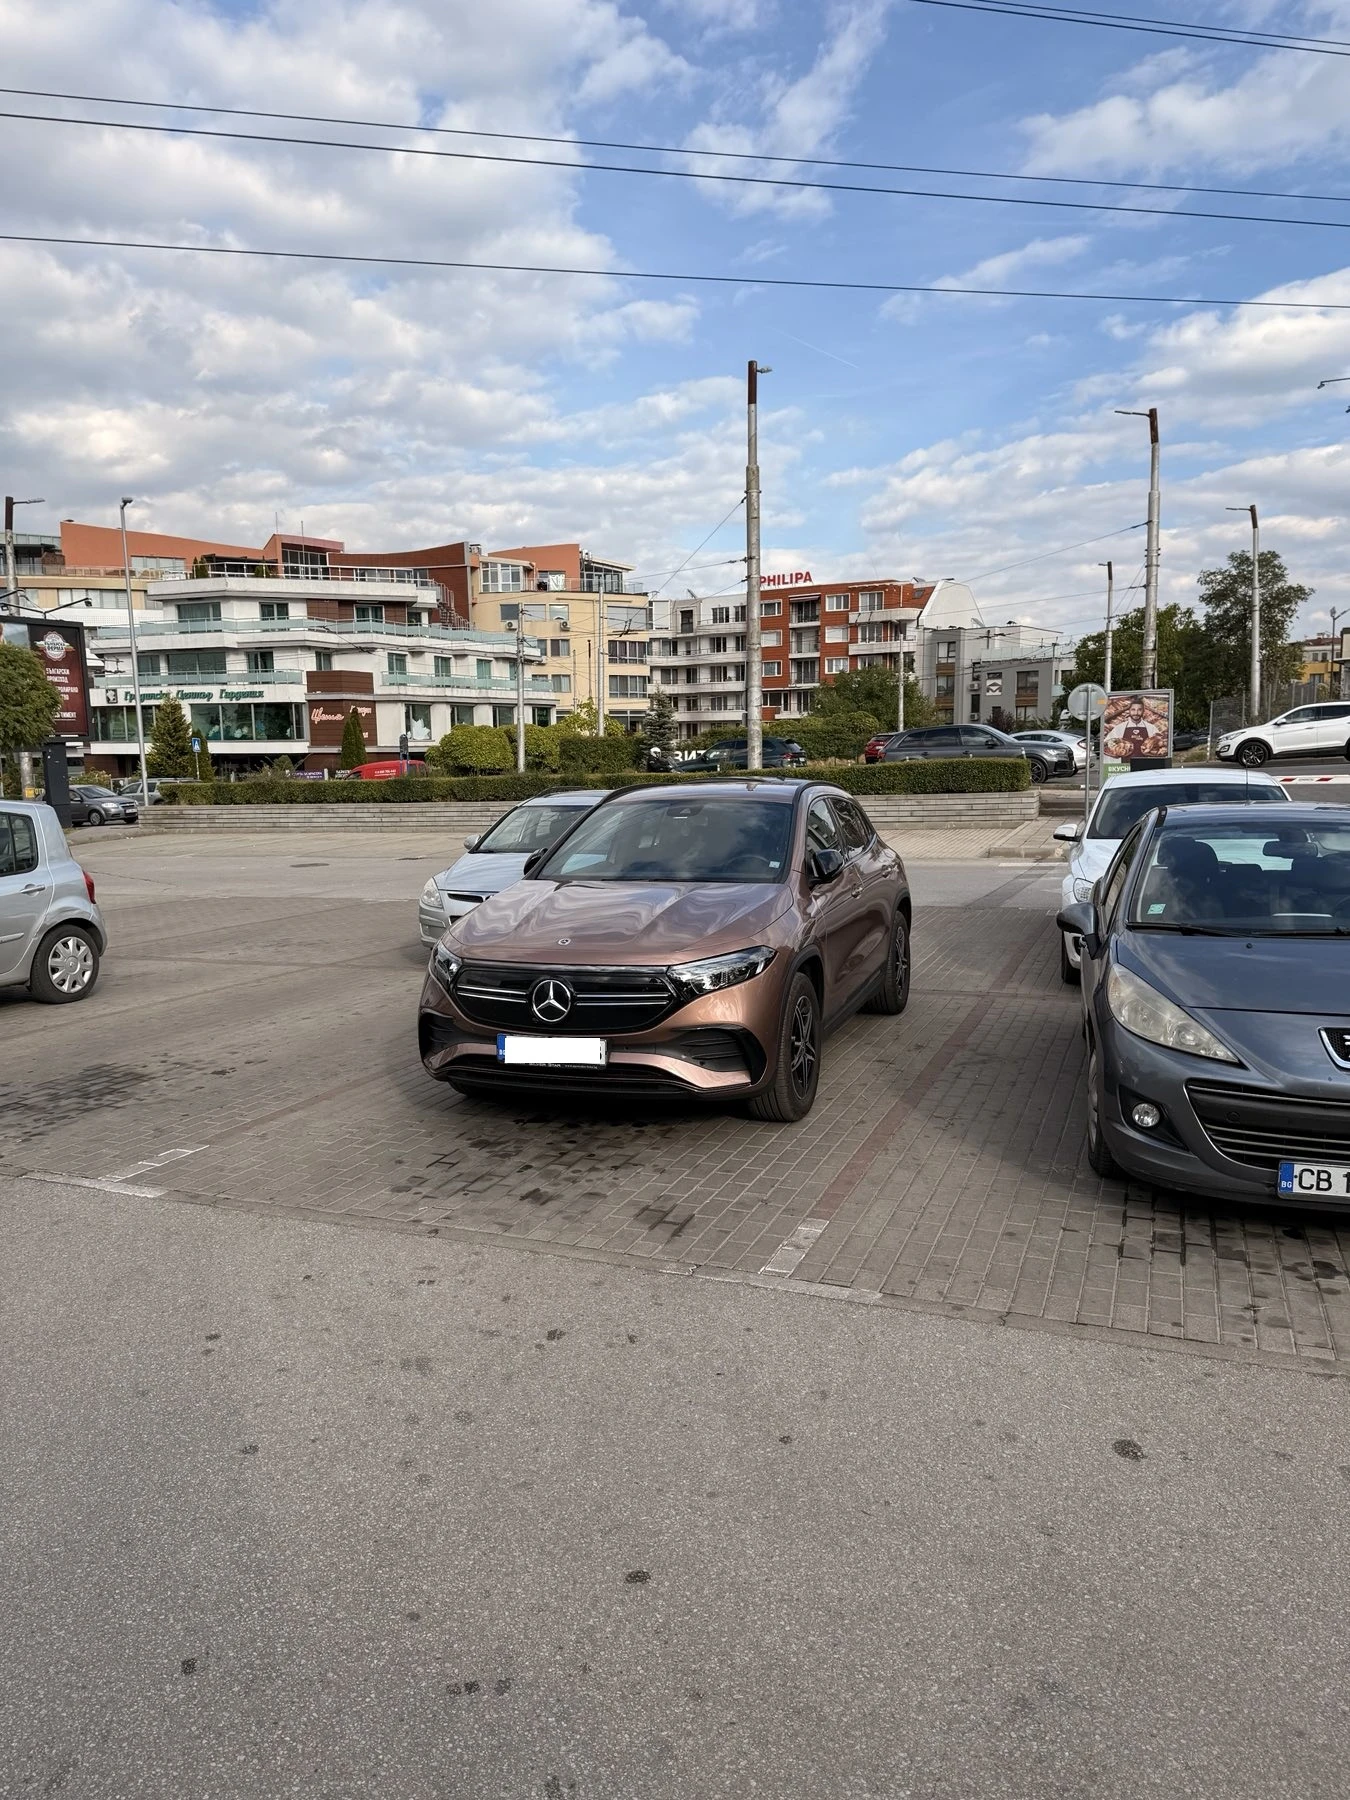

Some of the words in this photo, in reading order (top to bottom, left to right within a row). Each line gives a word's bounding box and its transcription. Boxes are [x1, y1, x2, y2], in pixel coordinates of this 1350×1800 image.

[760, 571, 813, 586] PHILIPA
[176, 690, 213, 701] Център
[219, 689, 264, 701] Гардения
[1281, 1180, 1293, 1188] BG
[1298, 1168, 1333, 1191] CB
